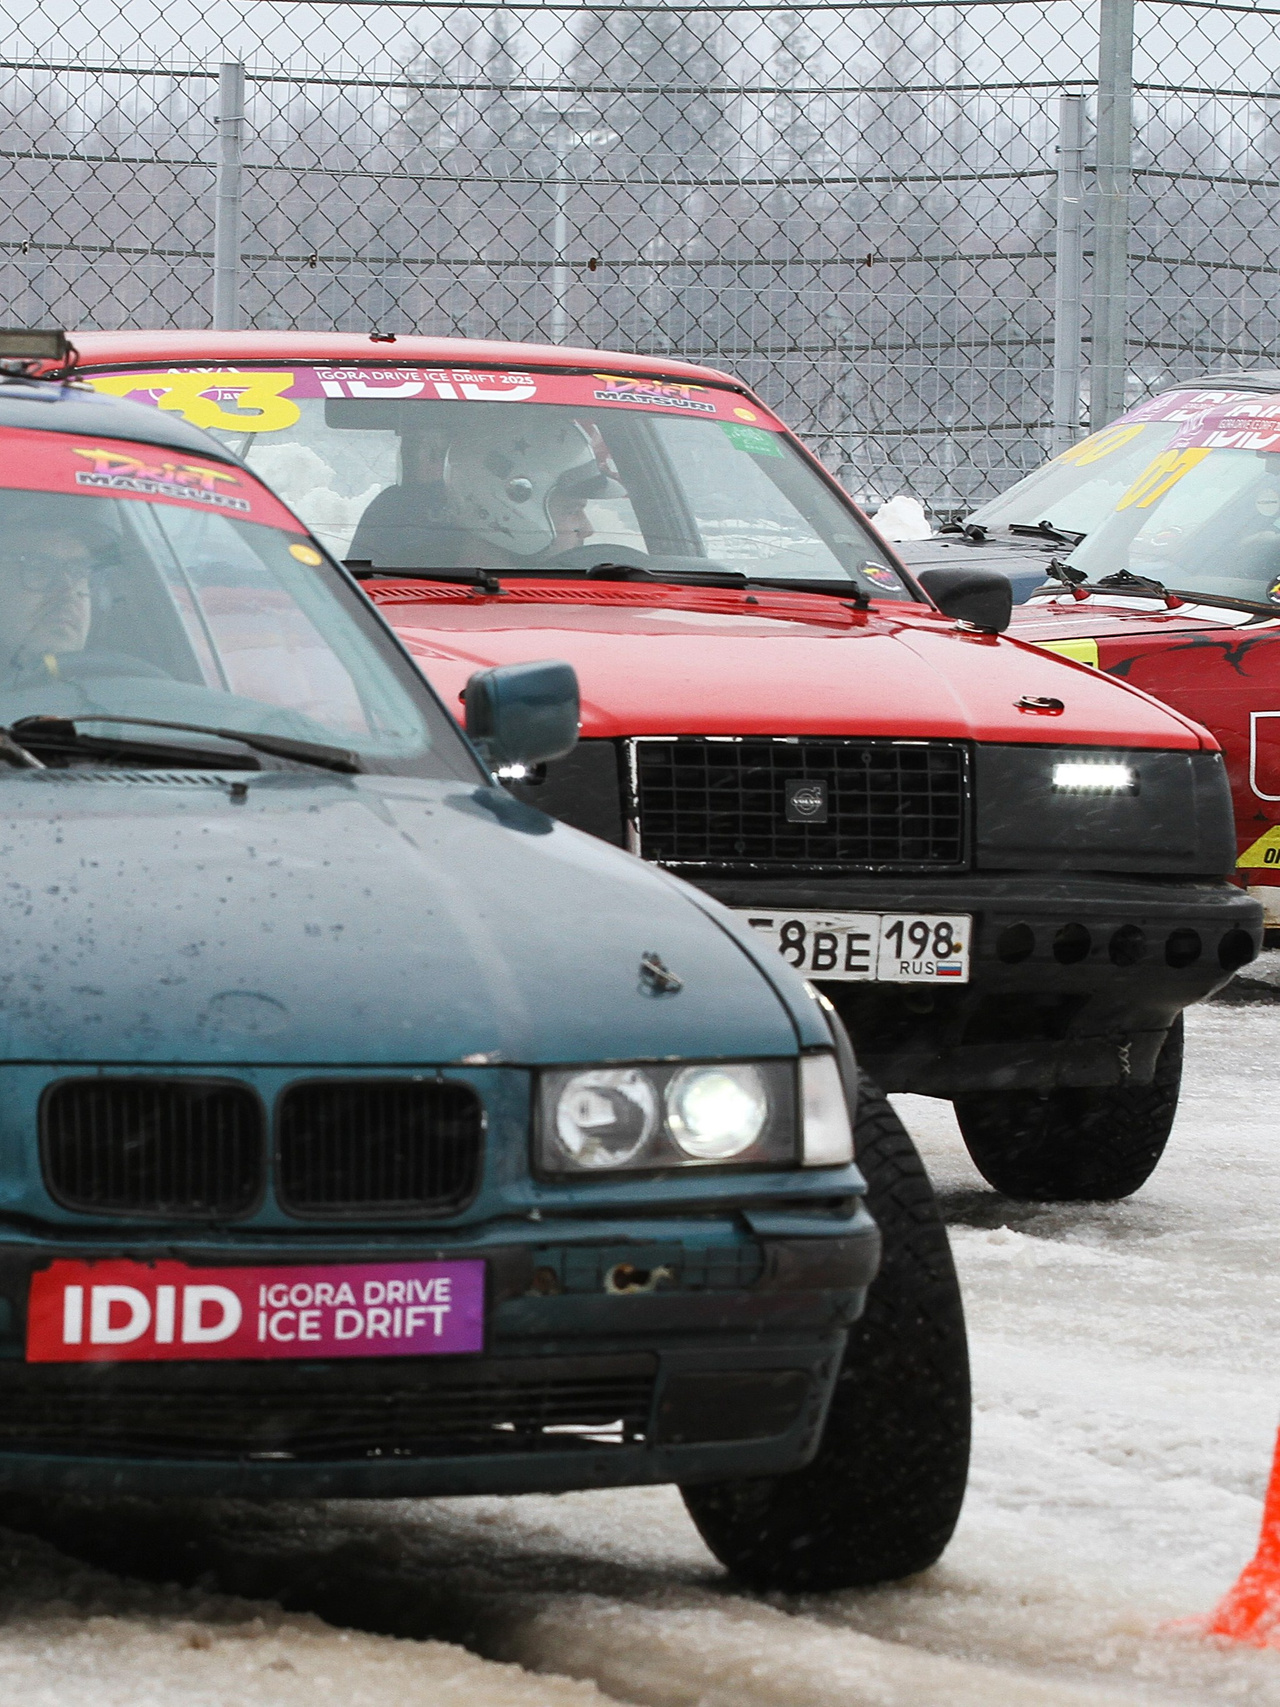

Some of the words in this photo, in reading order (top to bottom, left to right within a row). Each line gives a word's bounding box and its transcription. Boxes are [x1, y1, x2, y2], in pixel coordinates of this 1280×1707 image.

[317, 371, 371, 381] IGORA
[372, 371, 420, 382] DRIVE
[423, 372, 450, 382] ICE
[451, 373, 496, 384] DRIFT
[501, 374, 535, 385] 2025
[593, 391, 717, 413] MATSURI
[75, 471, 251, 512] MATSURI
[748, 918, 870, 972] 8BE
[885, 920, 954, 960] 198
[900, 961, 935, 975] RUS
[258, 1283, 356, 1308] IGORA
[363, 1278, 452, 1304] DRIVE
[62, 1285, 242, 1344] IDID
[258, 1309, 323, 1342] ICE
[333, 1305, 452, 1341] DRIFT
